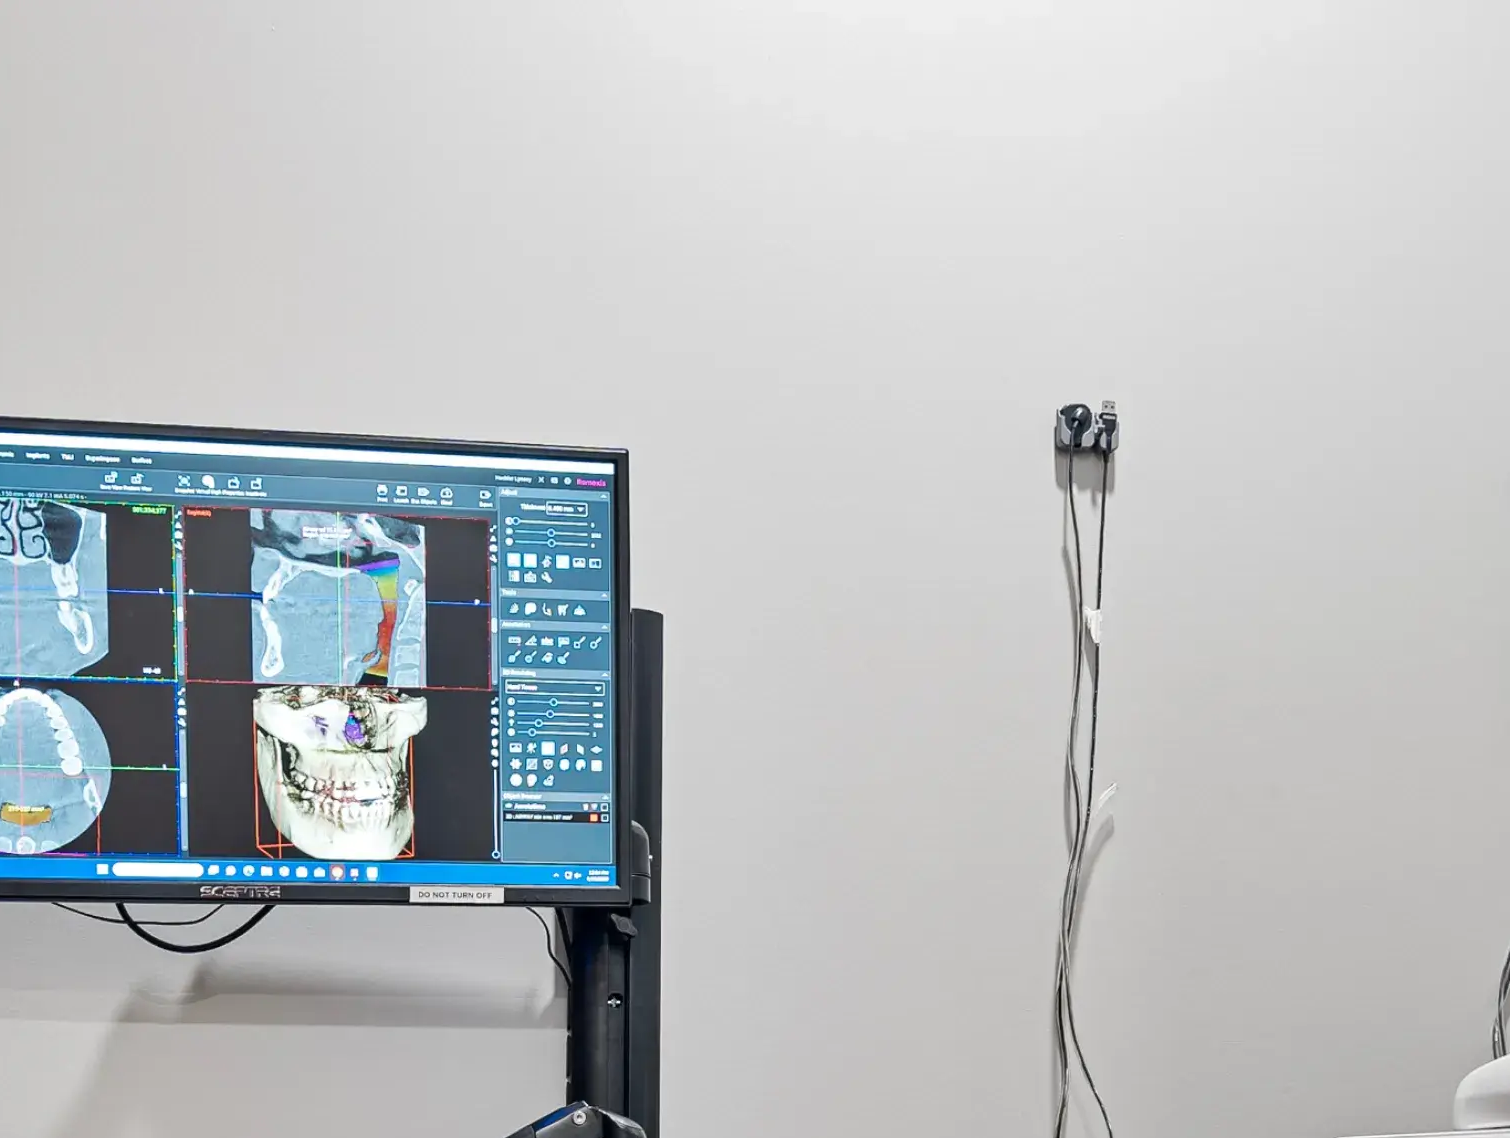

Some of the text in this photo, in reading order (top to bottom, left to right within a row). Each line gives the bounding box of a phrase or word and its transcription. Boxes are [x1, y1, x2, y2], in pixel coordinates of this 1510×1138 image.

[576, 478, 607, 488] Romexis
[199, 885, 281, 898] SCEPTRE
[432, 891, 449, 899] NOT
[452, 891, 474, 899] TURN
[475, 891, 493, 899] OFF
